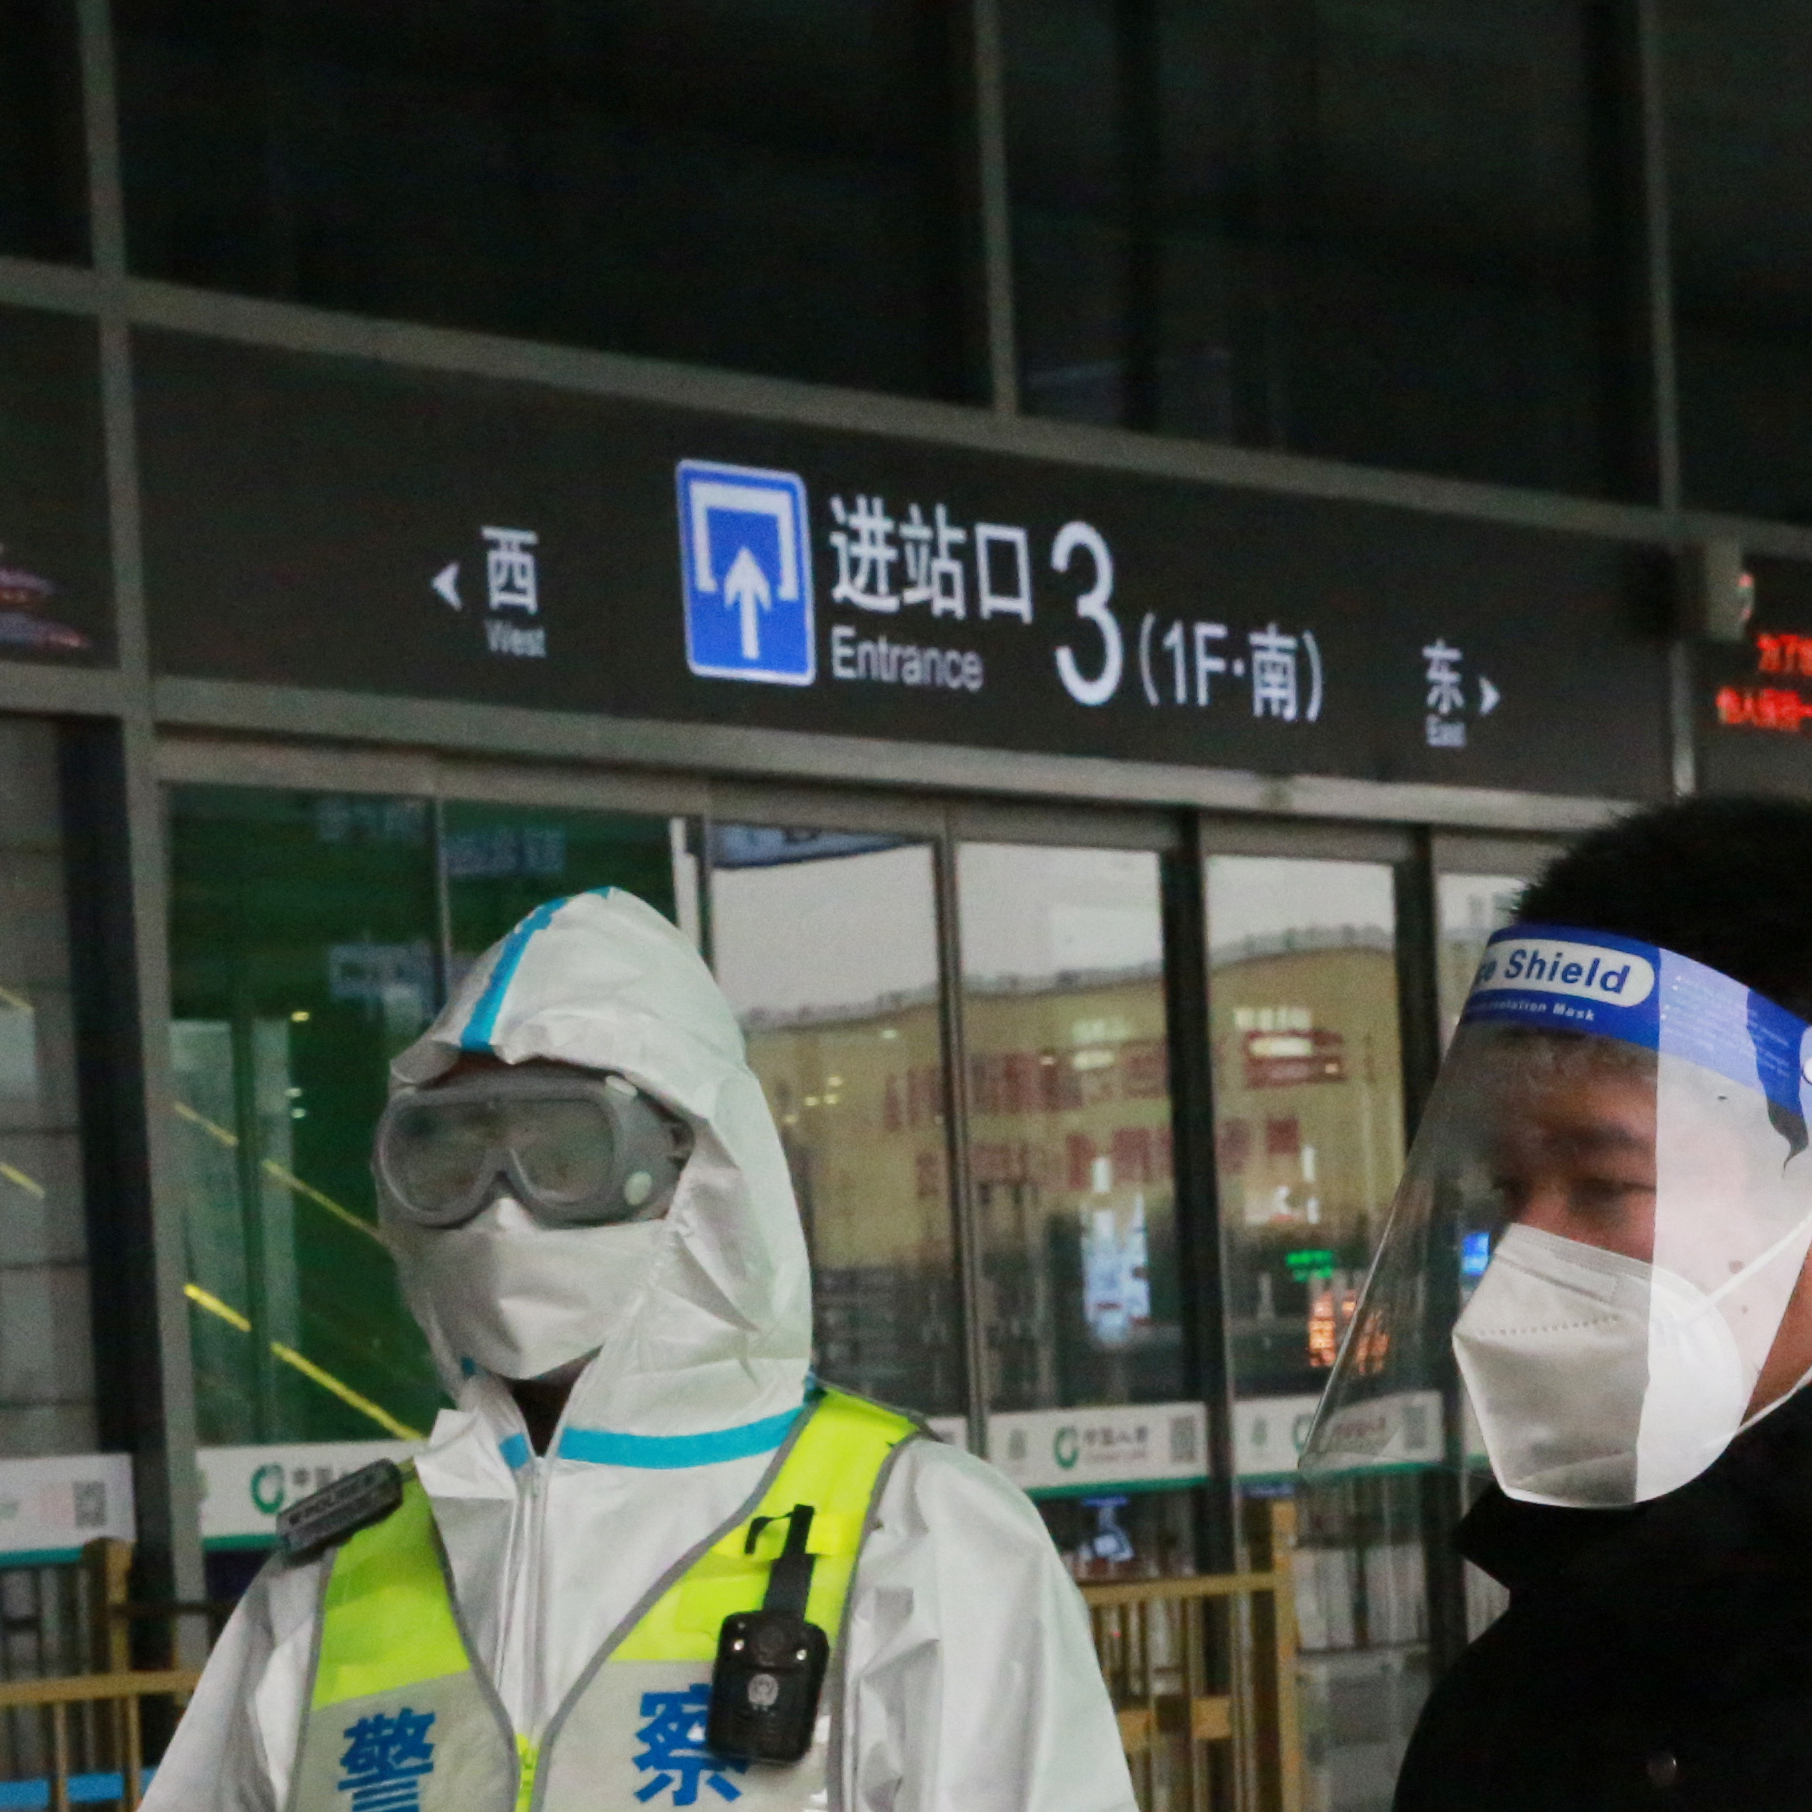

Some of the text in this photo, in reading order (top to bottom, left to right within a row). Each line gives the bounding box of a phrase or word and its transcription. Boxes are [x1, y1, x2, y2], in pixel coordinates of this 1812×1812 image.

[481, 525, 539, 615] 西
[829, 494, 1033, 625] 进站口
[1051, 520, 1125, 707] 3
[485, 619, 547, 658] West
[831, 624, 985, 693] Entrance
[1422, 637, 1464, 715] 东
[1504, 948, 1631, 995] Shield
[1551, 1002, 1596, 1022] Mask
